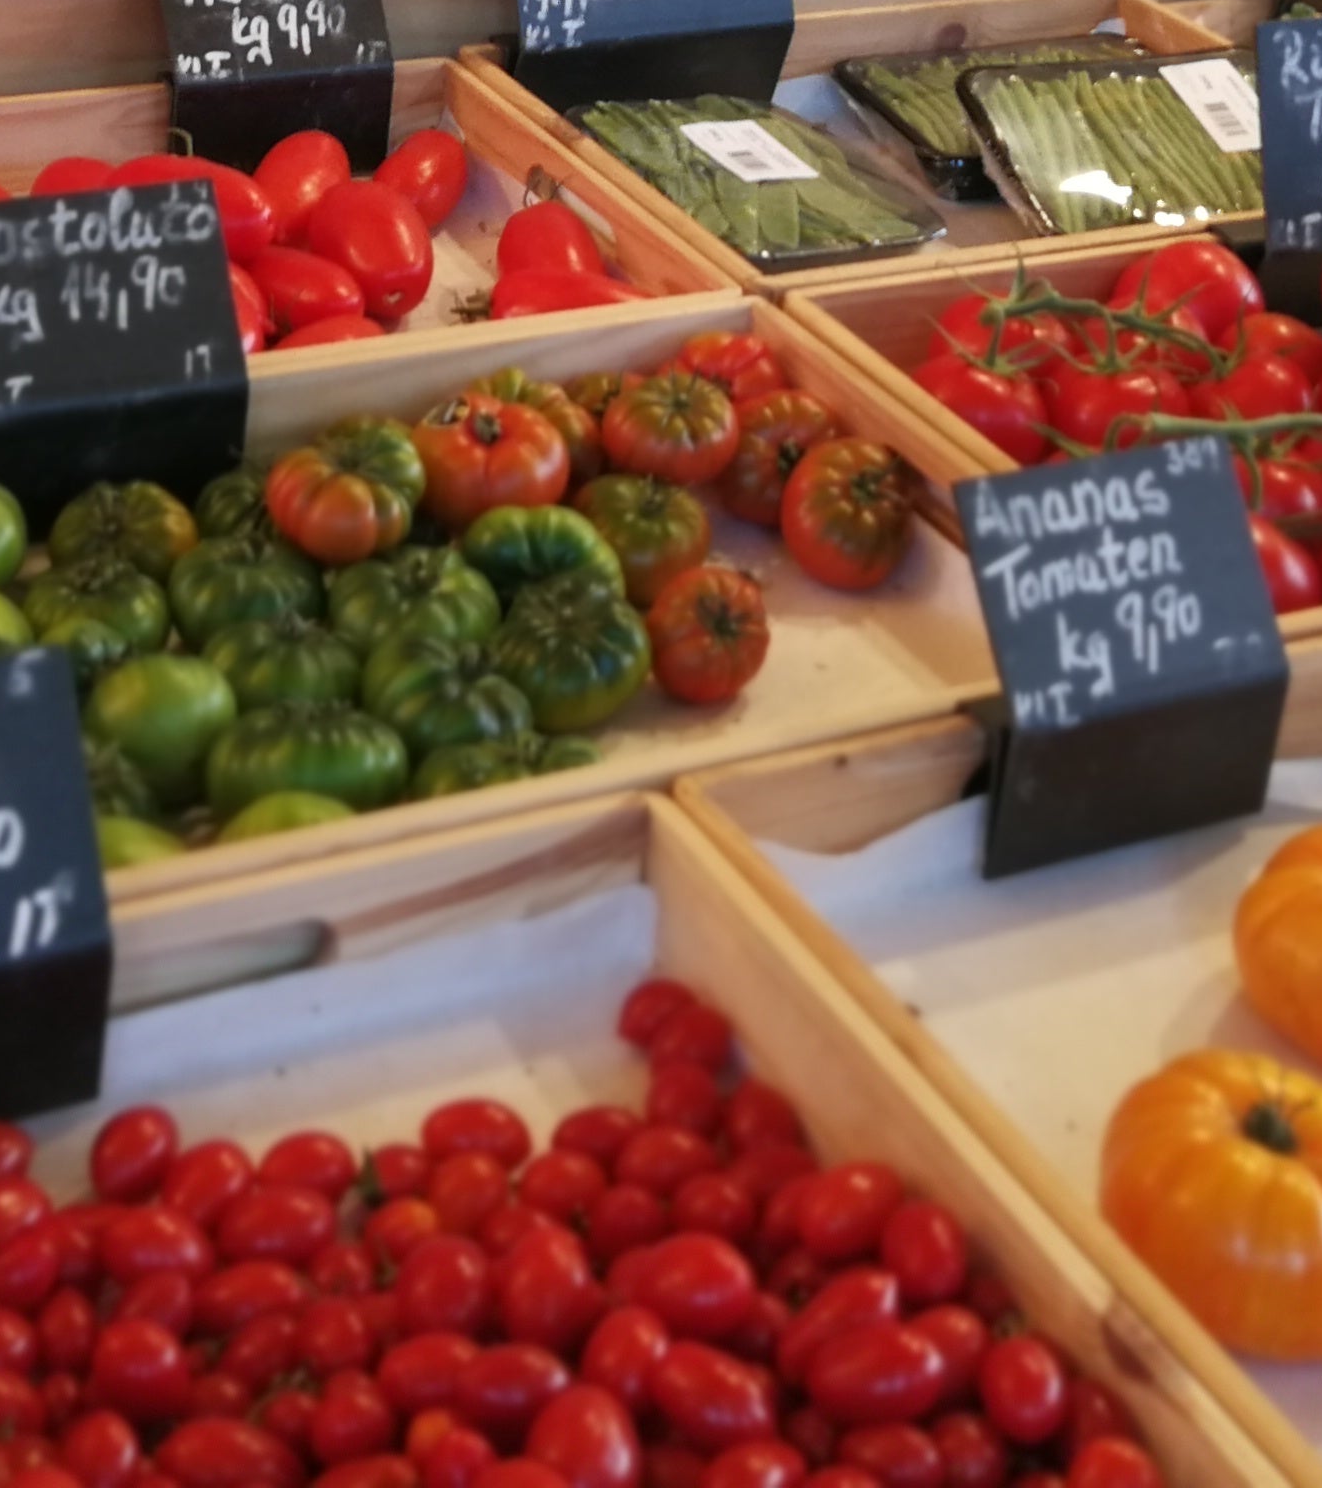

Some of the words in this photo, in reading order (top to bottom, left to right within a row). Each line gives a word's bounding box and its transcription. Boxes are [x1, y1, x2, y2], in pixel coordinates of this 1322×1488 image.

[230, 6, 273, 66] kg
[60, 253, 187, 331] 14,90
[974, 467, 1171, 541] Ananas
[982, 523, 1184, 624] Tomaten
[1056, 610, 1116, 699] kg
[1114, 583, 1203, 675] 9,90
